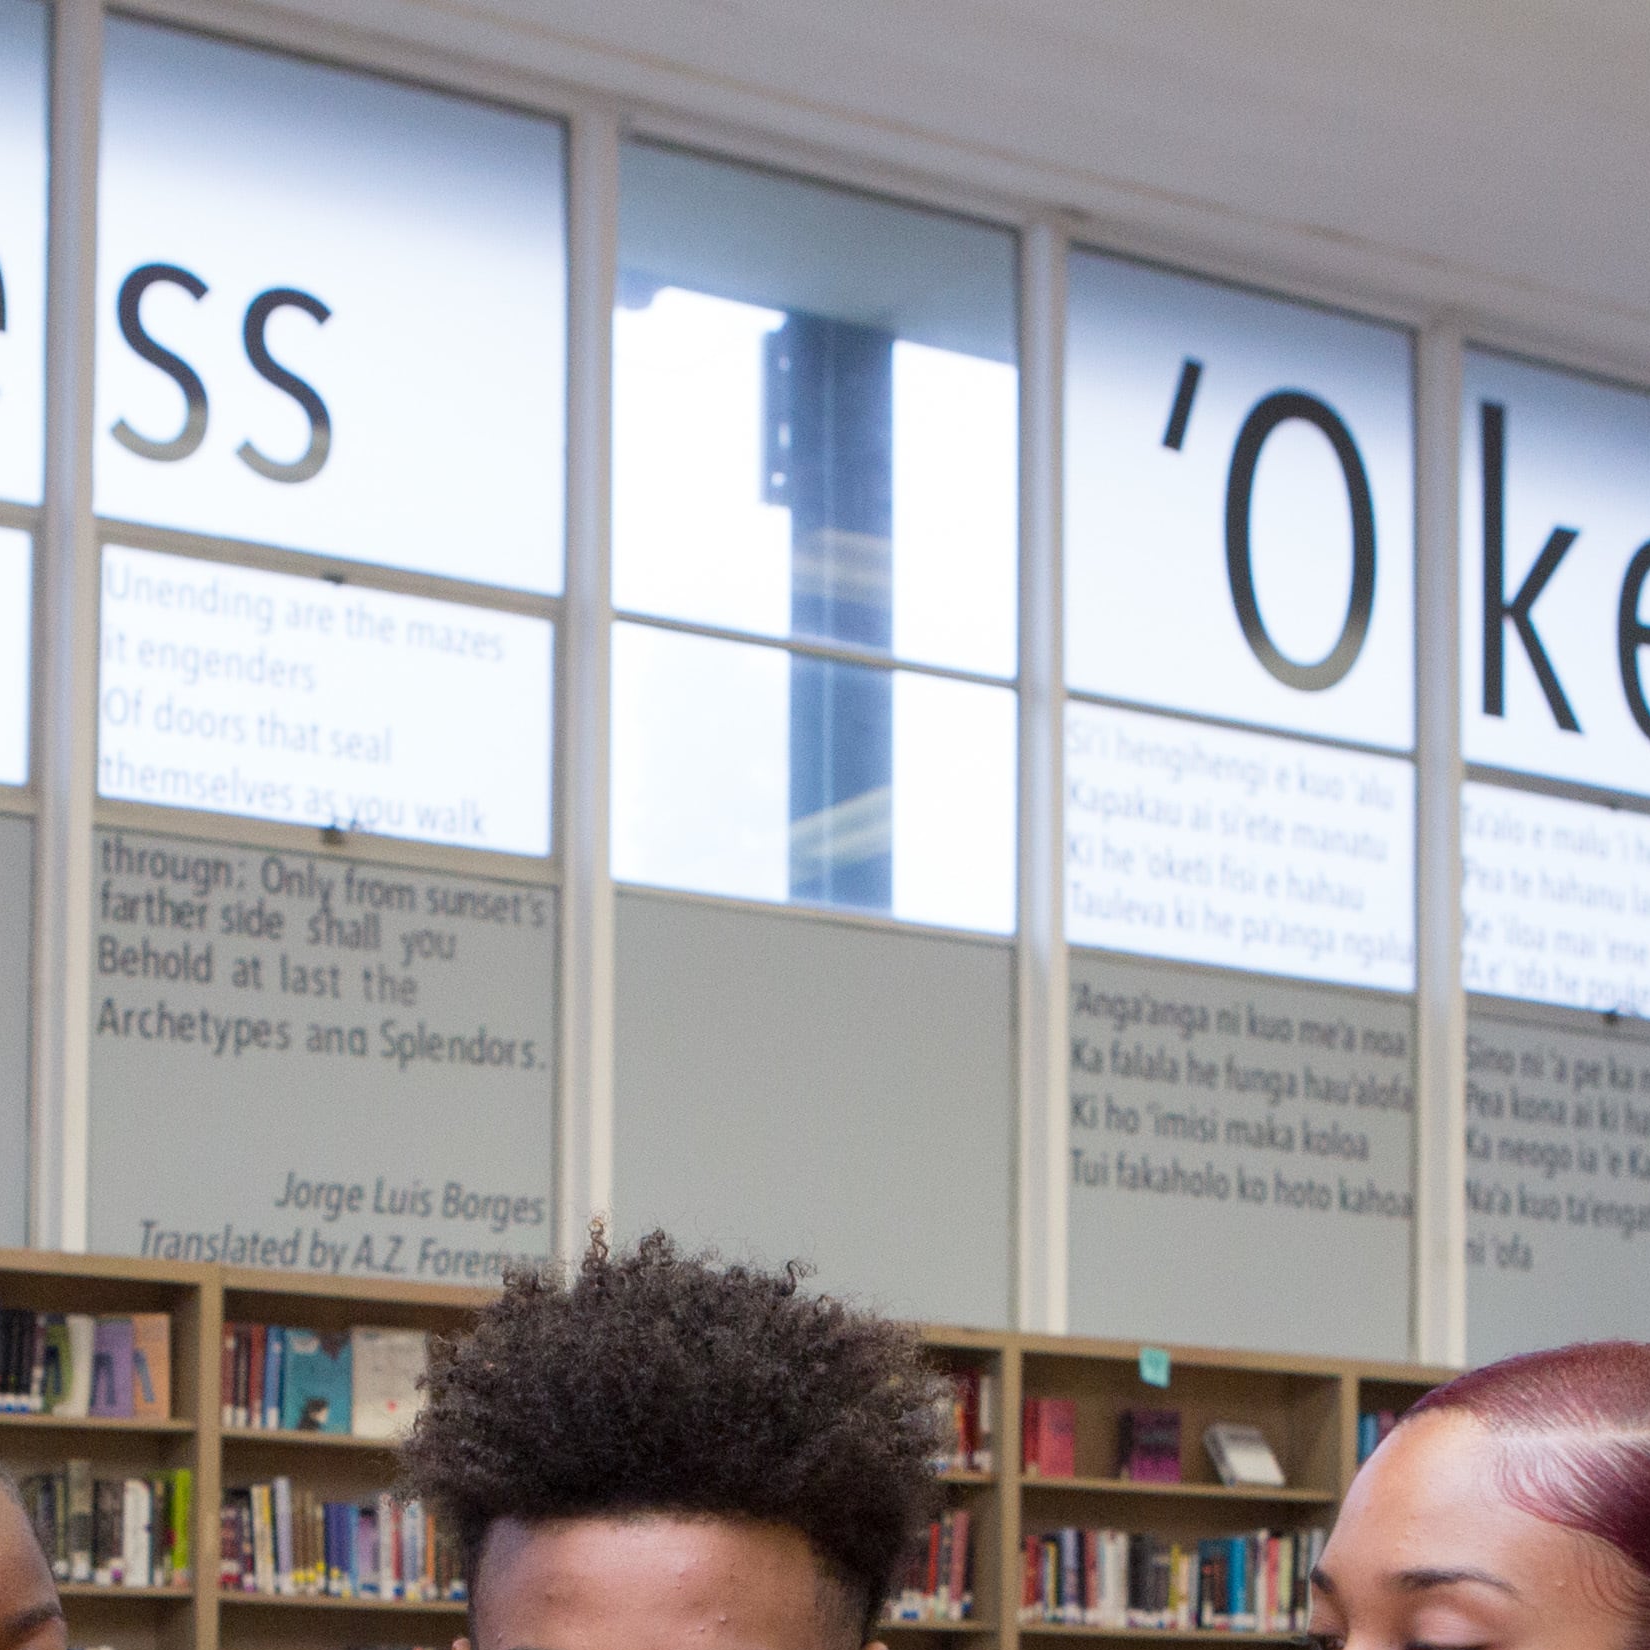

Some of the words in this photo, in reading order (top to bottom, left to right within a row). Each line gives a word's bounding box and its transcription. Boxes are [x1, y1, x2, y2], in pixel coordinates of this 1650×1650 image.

[105, 562, 275, 635] Unending
[285, 600, 335, 634] are
[344, 602, 396, 644] the
[406, 620, 504, 662] mazes
[137, 638, 316, 692] engenders
[104, 686, 143, 727] Of
[153, 694, 246, 744] doors
[256, 710, 320, 754] that
[330, 727, 391, 763] seal
[104, 752, 294, 803] themselves
[257, 852, 338, 915] Only
[344, 864, 419, 912] from
[100, 879, 209, 930] farther
[220, 898, 284, 940] side
[307, 905, 380, 950] shall
[400, 929, 455, 967] you
[97, 934, 213, 984] Behold
[231, 956, 262, 990] at
[279, 953, 340, 998] last
[362, 964, 417, 1006] the
[96, 997, 291, 1056] Archetypes
[379, 1019, 545, 1070] Splendors.
[274, 1171, 365, 1222] Jorge
[372, 1177, 432, 1218] Luis
[441, 1181, 544, 1233] Borges
[140, 1219, 301, 1266] Translated
[308, 1229, 347, 1270] by
